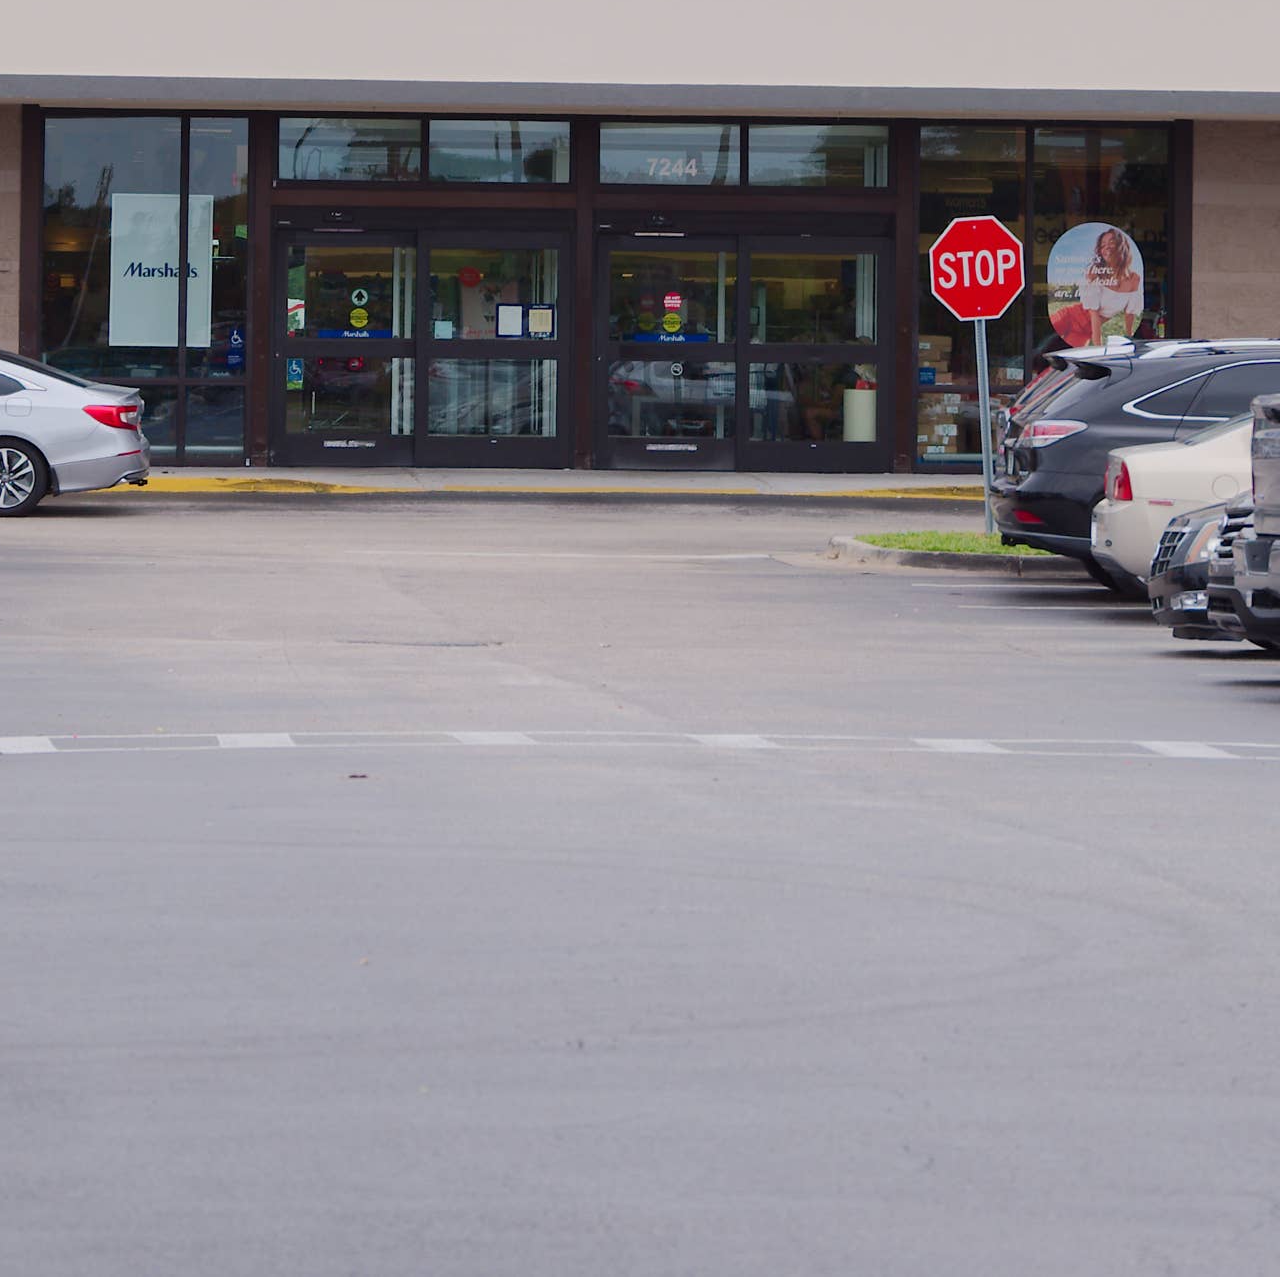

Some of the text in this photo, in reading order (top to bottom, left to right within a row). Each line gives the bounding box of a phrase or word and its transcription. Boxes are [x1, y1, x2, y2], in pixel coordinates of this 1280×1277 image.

[647, 158, 698, 177] 7244
[123, 262, 198, 278] Marshals
[938, 249, 1016, 289] STOP
